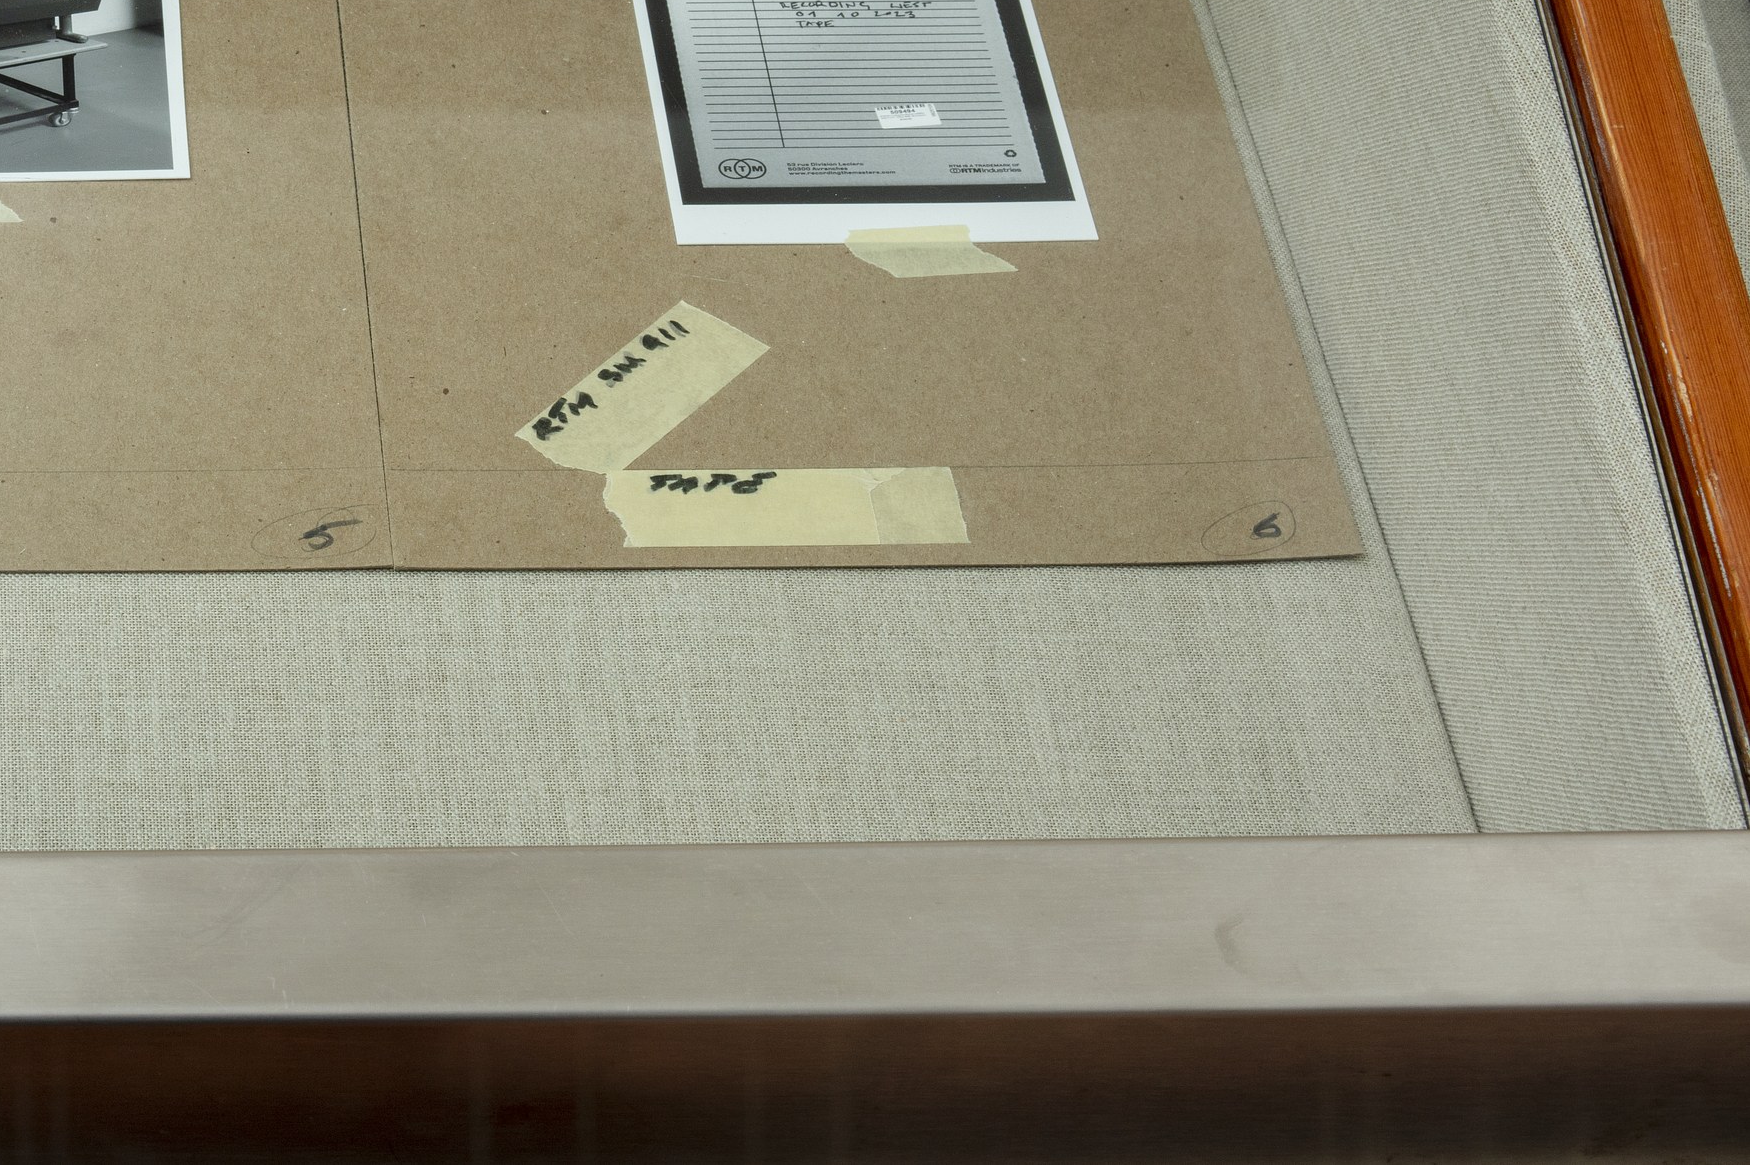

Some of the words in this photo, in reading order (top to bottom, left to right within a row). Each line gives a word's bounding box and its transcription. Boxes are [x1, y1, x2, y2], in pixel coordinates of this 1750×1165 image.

[779, 1, 870, 10] RECORDING
[890, 1, 932, 9] WEST
[796, 20, 835, 28] TAPE
[598, 351, 647, 388] SM
[649, 471, 778, 495] TAPE
[1250, 512, 1282, 540] 6
